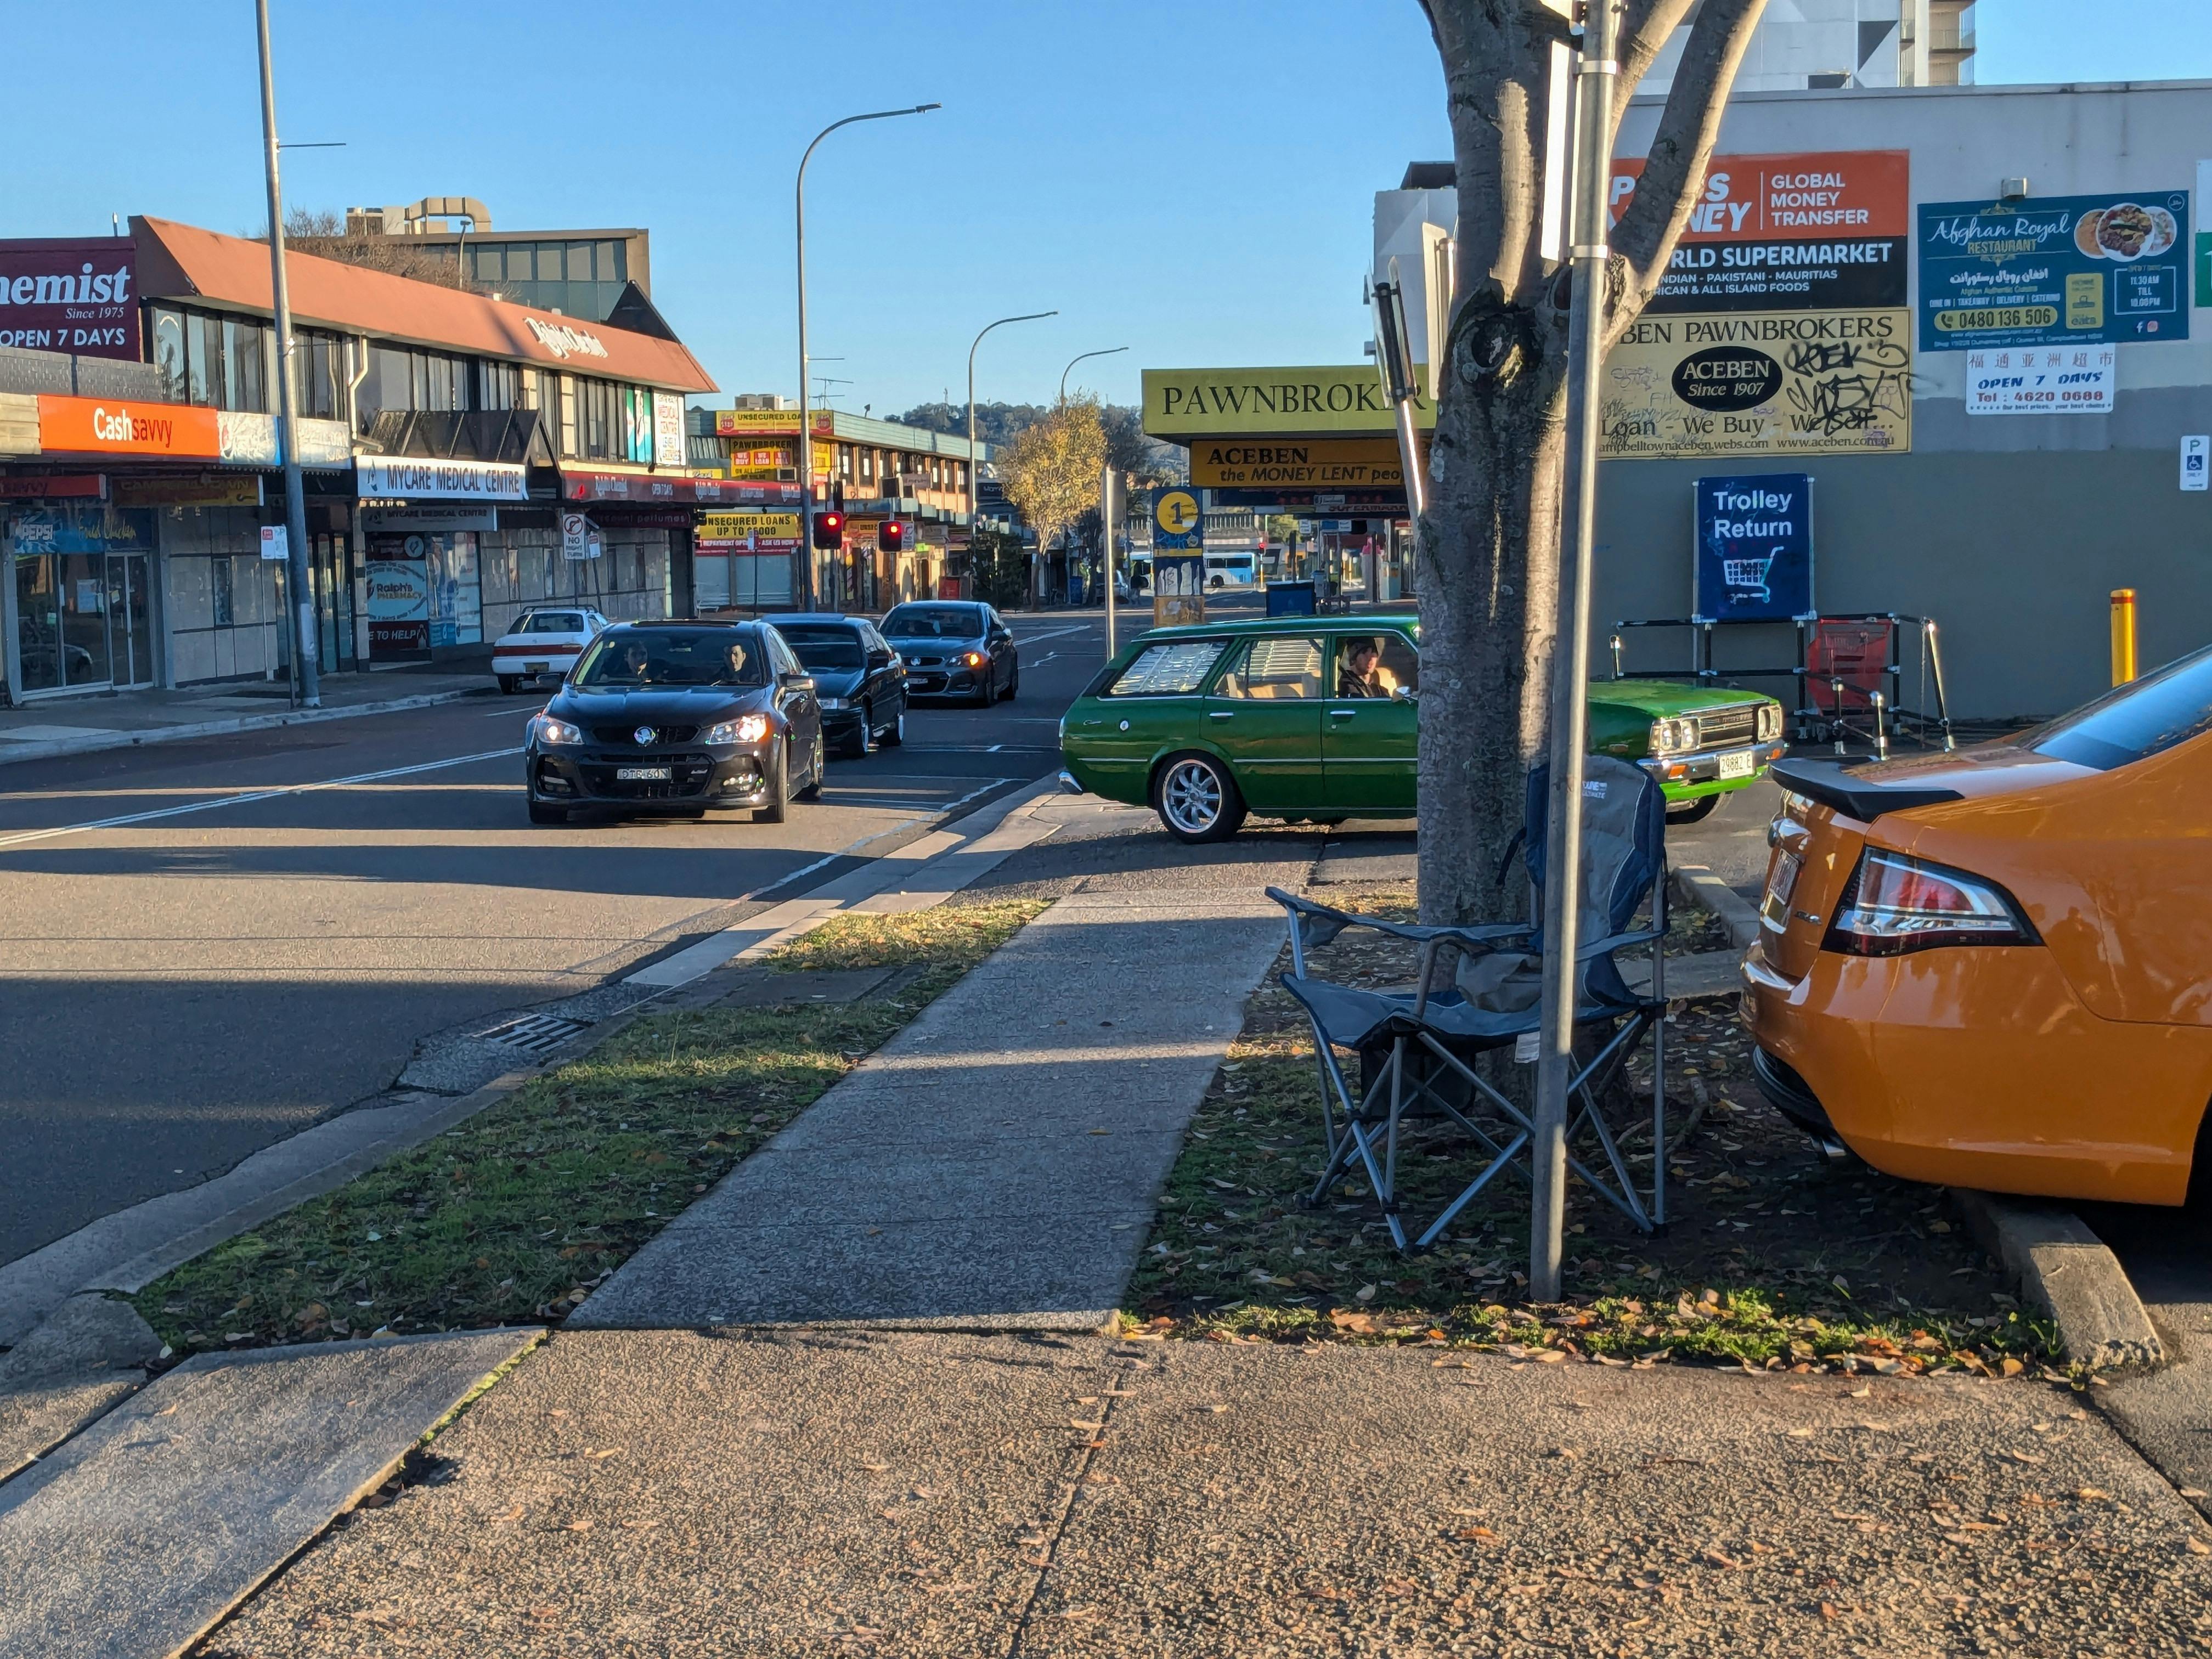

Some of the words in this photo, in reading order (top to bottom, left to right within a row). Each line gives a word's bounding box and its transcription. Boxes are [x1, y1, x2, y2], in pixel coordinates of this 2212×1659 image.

[1771, 173, 1846, 190] GLOBAL
[1771, 191, 1840, 208] MONEY
[1607, 201, 1752, 232] NEY
[1771, 209, 1869, 227] TRANSFER
[1927, 217, 2010, 246] Afghan
[2015, 213, 2070, 243] Royal
[1967, 239, 2037, 254] RESTAURANT
[1671, 248, 1716, 268] RLD
[1722, 243, 1893, 268] SUPERMARKET
[1660, 274, 1697, 284] NDIAN
[1707, 272, 1765, 282] PAKISTANI
[1775, 269, 1838, 280] MAURITIAS
[1654, 286, 1688, 296] RICAN
[1691, 286, 1699, 294] &
[1701, 285, 1723, 294] ALL
[1725, 284, 1766, 294] ISLAND
[1769, 282, 1810, 292] FOODS
[65, 308, 95, 320] Since
[98, 307, 125, 319] 1975
[1959, 312, 1995, 329] 0480
[1998, 309, 2021, 326] 136
[2025, 308, 2051, 325] 506
[0, 329, 50, 347] OPEN
[58, 329, 67, 346] 7
[74, 328, 125, 346] DAYS
[1620, 321, 1672, 345] BEN
[1684, 316, 1893, 343] PAWNBROKERS
[1682, 360, 1770, 380] ACEBEN
[1978, 376, 2024, 390] OPEN
[2036, 375, 2045, 385] 7
[2057, 371, 2103, 385] DAYS
[1687, 382, 1726, 398] Since
[1733, 382, 1765, 397] 1907
[2014, 391, 2055, 402] 4620
[1162, 383, 1427, 415] PAWNBROKR
[94, 407, 173, 448] Cashsavvy
[1682, 416, 1714, 434] We
[1723, 415, 1765, 438] Buy
[1599, 438, 1769, 454] ampbelltownaceben.webs.com
[2190, 439, 2200, 453] P
[1207, 447, 1308, 465] ACEBEN
[386, 464, 431, 490] MYCARE
[436, 466, 481, 492] MEDICAL
[485, 467, 520, 493] CENTRE
[1220, 467, 1245, 482] the
[1250, 466, 1317, 482] MONEY
[1321, 466, 1368, 481] LENT
[1713, 490, 1792, 512] Trolley
[761, 516, 791, 525] LOANS
[1170, 501, 1184, 524] 1
[21, 524, 53, 540] PEPSI
[716, 527, 729, 536] UP
[732, 527, 744, 536] TO
[1714, 519, 1792, 539] Return
[568, 537, 580, 545] NO
[376, 583, 413, 592] Ralph's
[377, 631, 389, 640] TO
[391, 630, 417, 640] HELP
